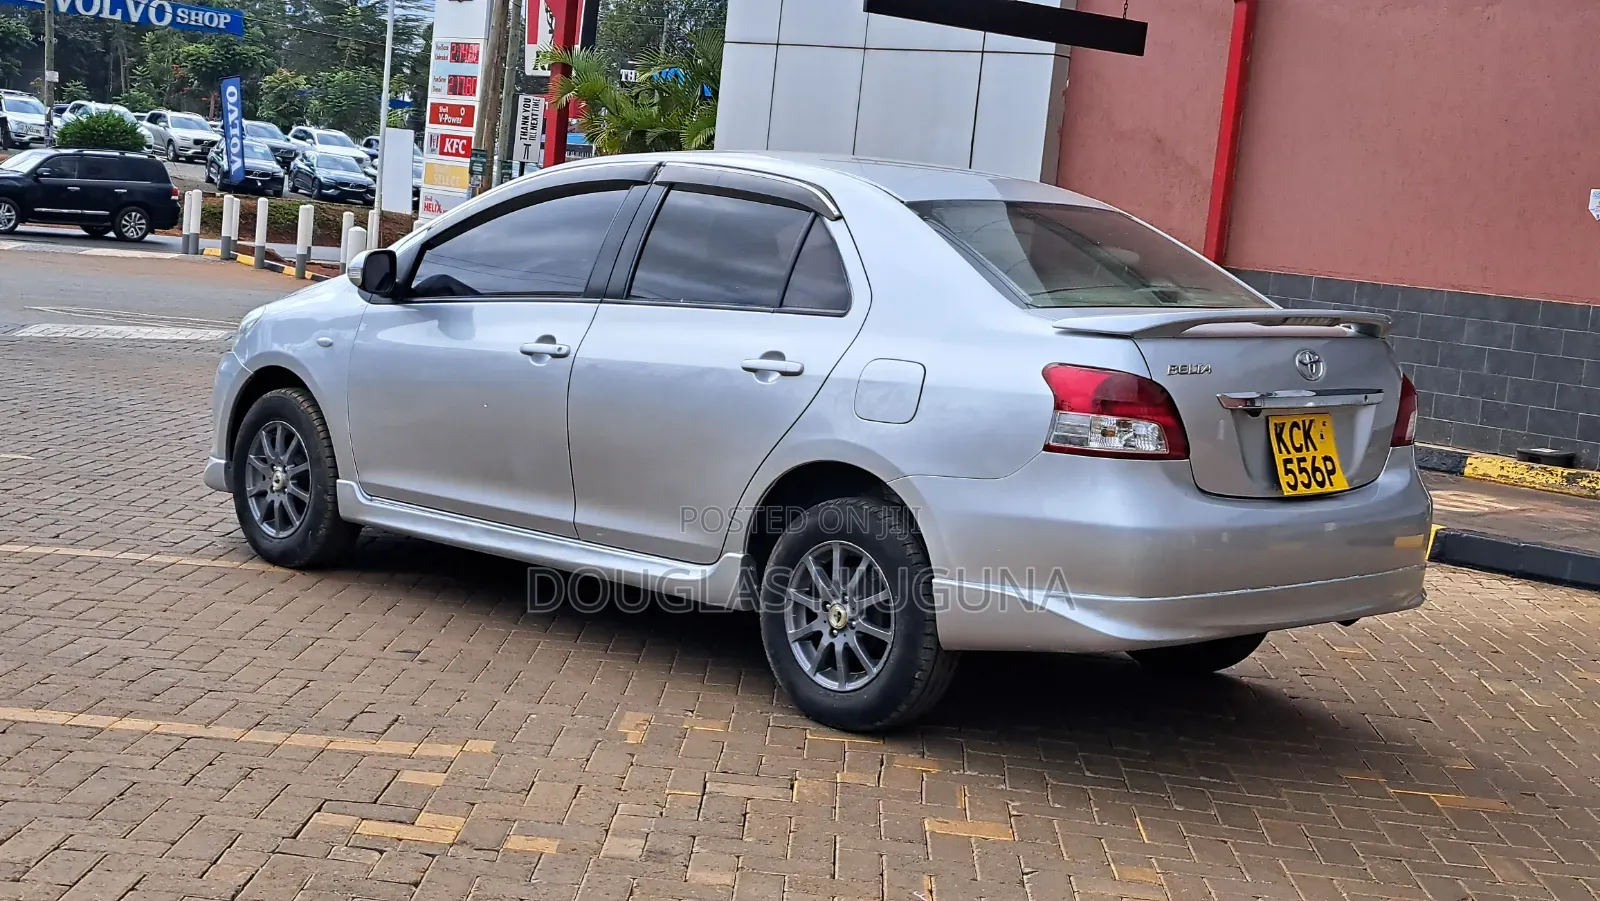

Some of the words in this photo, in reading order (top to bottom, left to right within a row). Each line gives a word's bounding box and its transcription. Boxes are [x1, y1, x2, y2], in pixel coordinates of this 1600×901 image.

[53, 0, 173, 26] VOLVO
[175, 7, 232, 29] SHOP
[522, 97, 532, 113] YOU
[532, 98, 541, 111] TIME
[438, 113, 463, 124] V-Power
[530, 113, 539, 131] NEXT
[225, 85, 241, 175] VOLVO
[520, 115, 530, 141] THANK
[529, 131, 538, 141] TILL
[443, 137, 467, 155] KFC
[433, 173, 461, 187] SELECT
[423, 202, 443, 213] HELIX
[1166, 363, 1212, 376] BELTA
[1273, 418, 1318, 455] KCK
[1282, 455, 1337, 492] 556P
